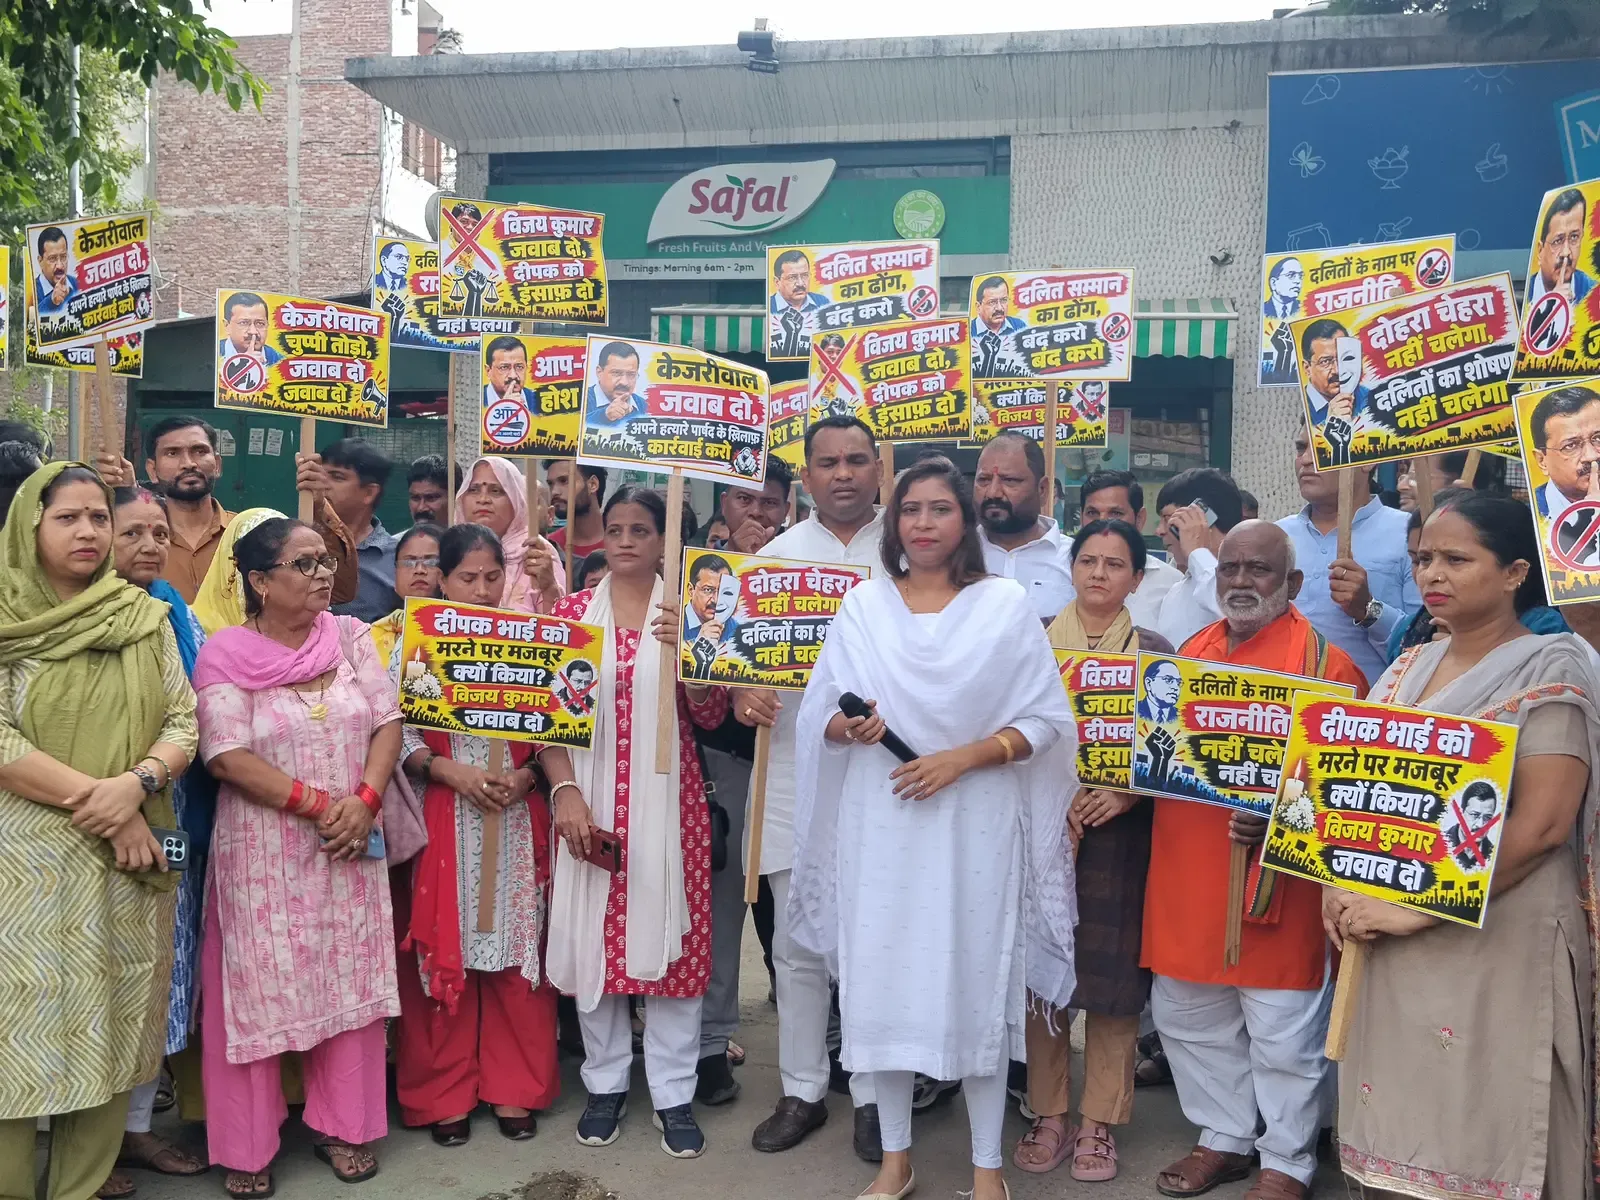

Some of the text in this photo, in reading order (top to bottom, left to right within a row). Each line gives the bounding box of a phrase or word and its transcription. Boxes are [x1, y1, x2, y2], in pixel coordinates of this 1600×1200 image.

[688, 176, 790, 222] Safal
[78, 219, 144, 253] केजरीवाल
[502, 212, 595, 237] विजय कुमार
[508, 236, 587, 259] जवाब दो,
[658, 242, 690, 253] Fresh
[692, 242, 726, 253] Fruits
[729, 241, 752, 252] And
[83, 243, 146, 285] जवाब दो,
[512, 259, 585, 282] दीपक को
[623, 264, 661, 274] Timings:
[664, 264, 701, 274] Morning
[703, 264, 725, 272] 6am
[734, 263, 755, 273] 2pm
[820, 249, 928, 280] दलित सम्मान
[1309, 251, 1416, 284] दलितों के नाम पर
[575, 278, 595, 302] दो
[840, 273, 907, 300] का ढोंग,
[1018, 275, 1123, 305] दलित सम्मान
[118, 294, 135, 314] करो
[826, 298, 893, 326] बंद करो
[1036, 299, 1101, 323] का ढोंग,
[281, 302, 379, 335] केजरीवाल
[1367, 292, 1495, 350] दोहरा चेहरा
[285, 331, 327, 356] चुप्पी
[863, 323, 961, 359] विजय कुमार
[1022, 323, 1087, 349] बंद करो
[1384, 323, 1493, 368] नहीं चलेगा,
[868, 348, 951, 380] जवाब दो,
[1031, 339, 1105, 369] बंद करो
[289, 359, 366, 383] जवाब दो
[656, 352, 759, 390] केजरीवाल
[283, 383, 348, 402] जवाब दो
[540, 385, 579, 413] होश
[871, 372, 946, 403] दीपक को
[996, 389, 1023, 407] क्यों
[1374, 367, 1435, 412] दलितों
[1436, 365, 1462, 389] का
[659, 389, 758, 425] जवाब दो,
[935, 391, 957, 415] दो
[996, 409, 1032, 424] विजय
[1395, 381, 1508, 429] नहीं चलेगा
[630, 419, 657, 436] अपने
[659, 421, 689, 437] हत्यारे
[691, 422, 715, 439] पार्षद
[716, 424, 726, 439] के
[790, 416, 804, 436] में
[647, 436, 732, 460] कार्रवाई करो
[747, 567, 854, 596] दोहरा चेहरा
[756, 591, 791, 616] नहीं
[434, 609, 571, 645] दीपक भाई को
[741, 620, 793, 646] दलितों
[794, 624, 815, 641] का
[436, 638, 564, 667] मरने पर मजबूर
[755, 641, 791, 667] नहीं
[453, 662, 546, 686] क्यों किया?
[1080, 660, 1133, 687] विजय
[1189, 673, 1238, 697] दलितों
[1241, 679, 1257, 698] के
[1258, 684, 1288, 702] नाम
[452, 685, 551, 708] विजय कुमार
[464, 710, 545, 733] जवाब दो
[1194, 702, 1291, 735] राजनीति
[1320, 707, 1475, 757] दीपक भाई को
[1199, 736, 1245, 762] नहीं
[1217, 760, 1260, 785] नहीं
[1318, 747, 1462, 790] मरने पर मजबूर
[1329, 781, 1436, 819] क्यों किया?
[1323, 816, 1437, 854] विजय कुमार
[1332, 850, 1425, 891] जवाब दो
